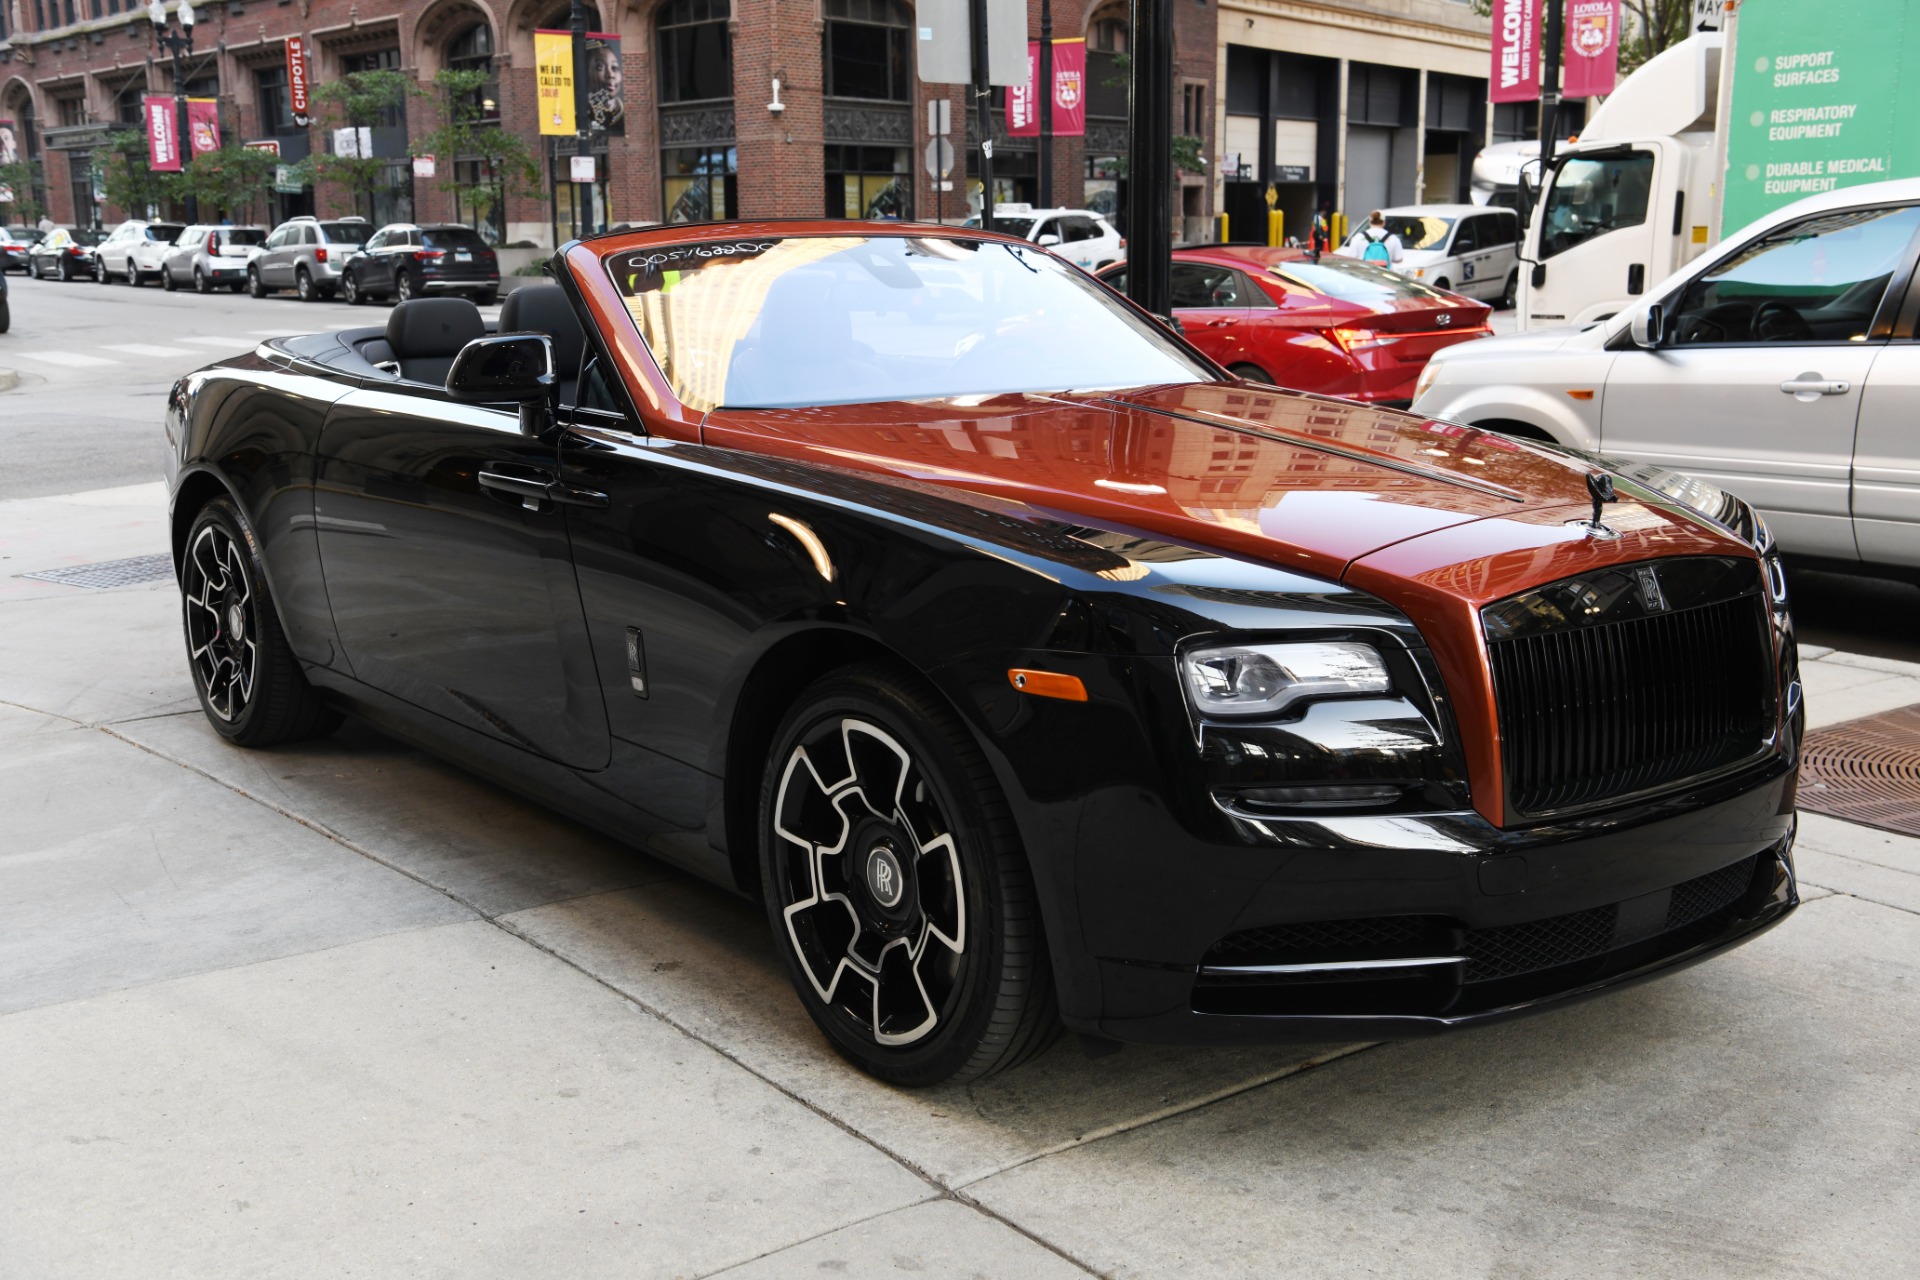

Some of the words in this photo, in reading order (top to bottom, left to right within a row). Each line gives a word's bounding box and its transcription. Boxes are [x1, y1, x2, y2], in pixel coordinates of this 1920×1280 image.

[1524, 0, 1533, 19] CAM
[1573, 1, 1613, 13] LOYOLA
[1697, 0, 1722, 15] WAY
[1501, 0, 1522, 88] WELCOM
[1522, 21, 1532, 50] TOWER
[540, 65, 549, 74] WE
[551, 65, 562, 75] ARE
[1522, 52, 1531, 80] WATER
[1775, 51, 1834, 70] SUPPORT
[290, 41, 306, 109] CHIPOTLE
[540, 76, 562, 86] CALLED
[563, 77, 571, 87] TO
[1773, 68, 1840, 87] SURFACES
[1013, 85, 1026, 129] WELC
[1770, 104, 1857, 124] RESPIRATORY
[151, 105, 168, 163] WELCOME
[1769, 122, 1842, 141] EQUIPMENT
[1766, 161, 1824, 178] DURABLE
[1827, 158, 1885, 174] MEDICAL
[1764, 177, 1837, 194] EQUIPMENT
